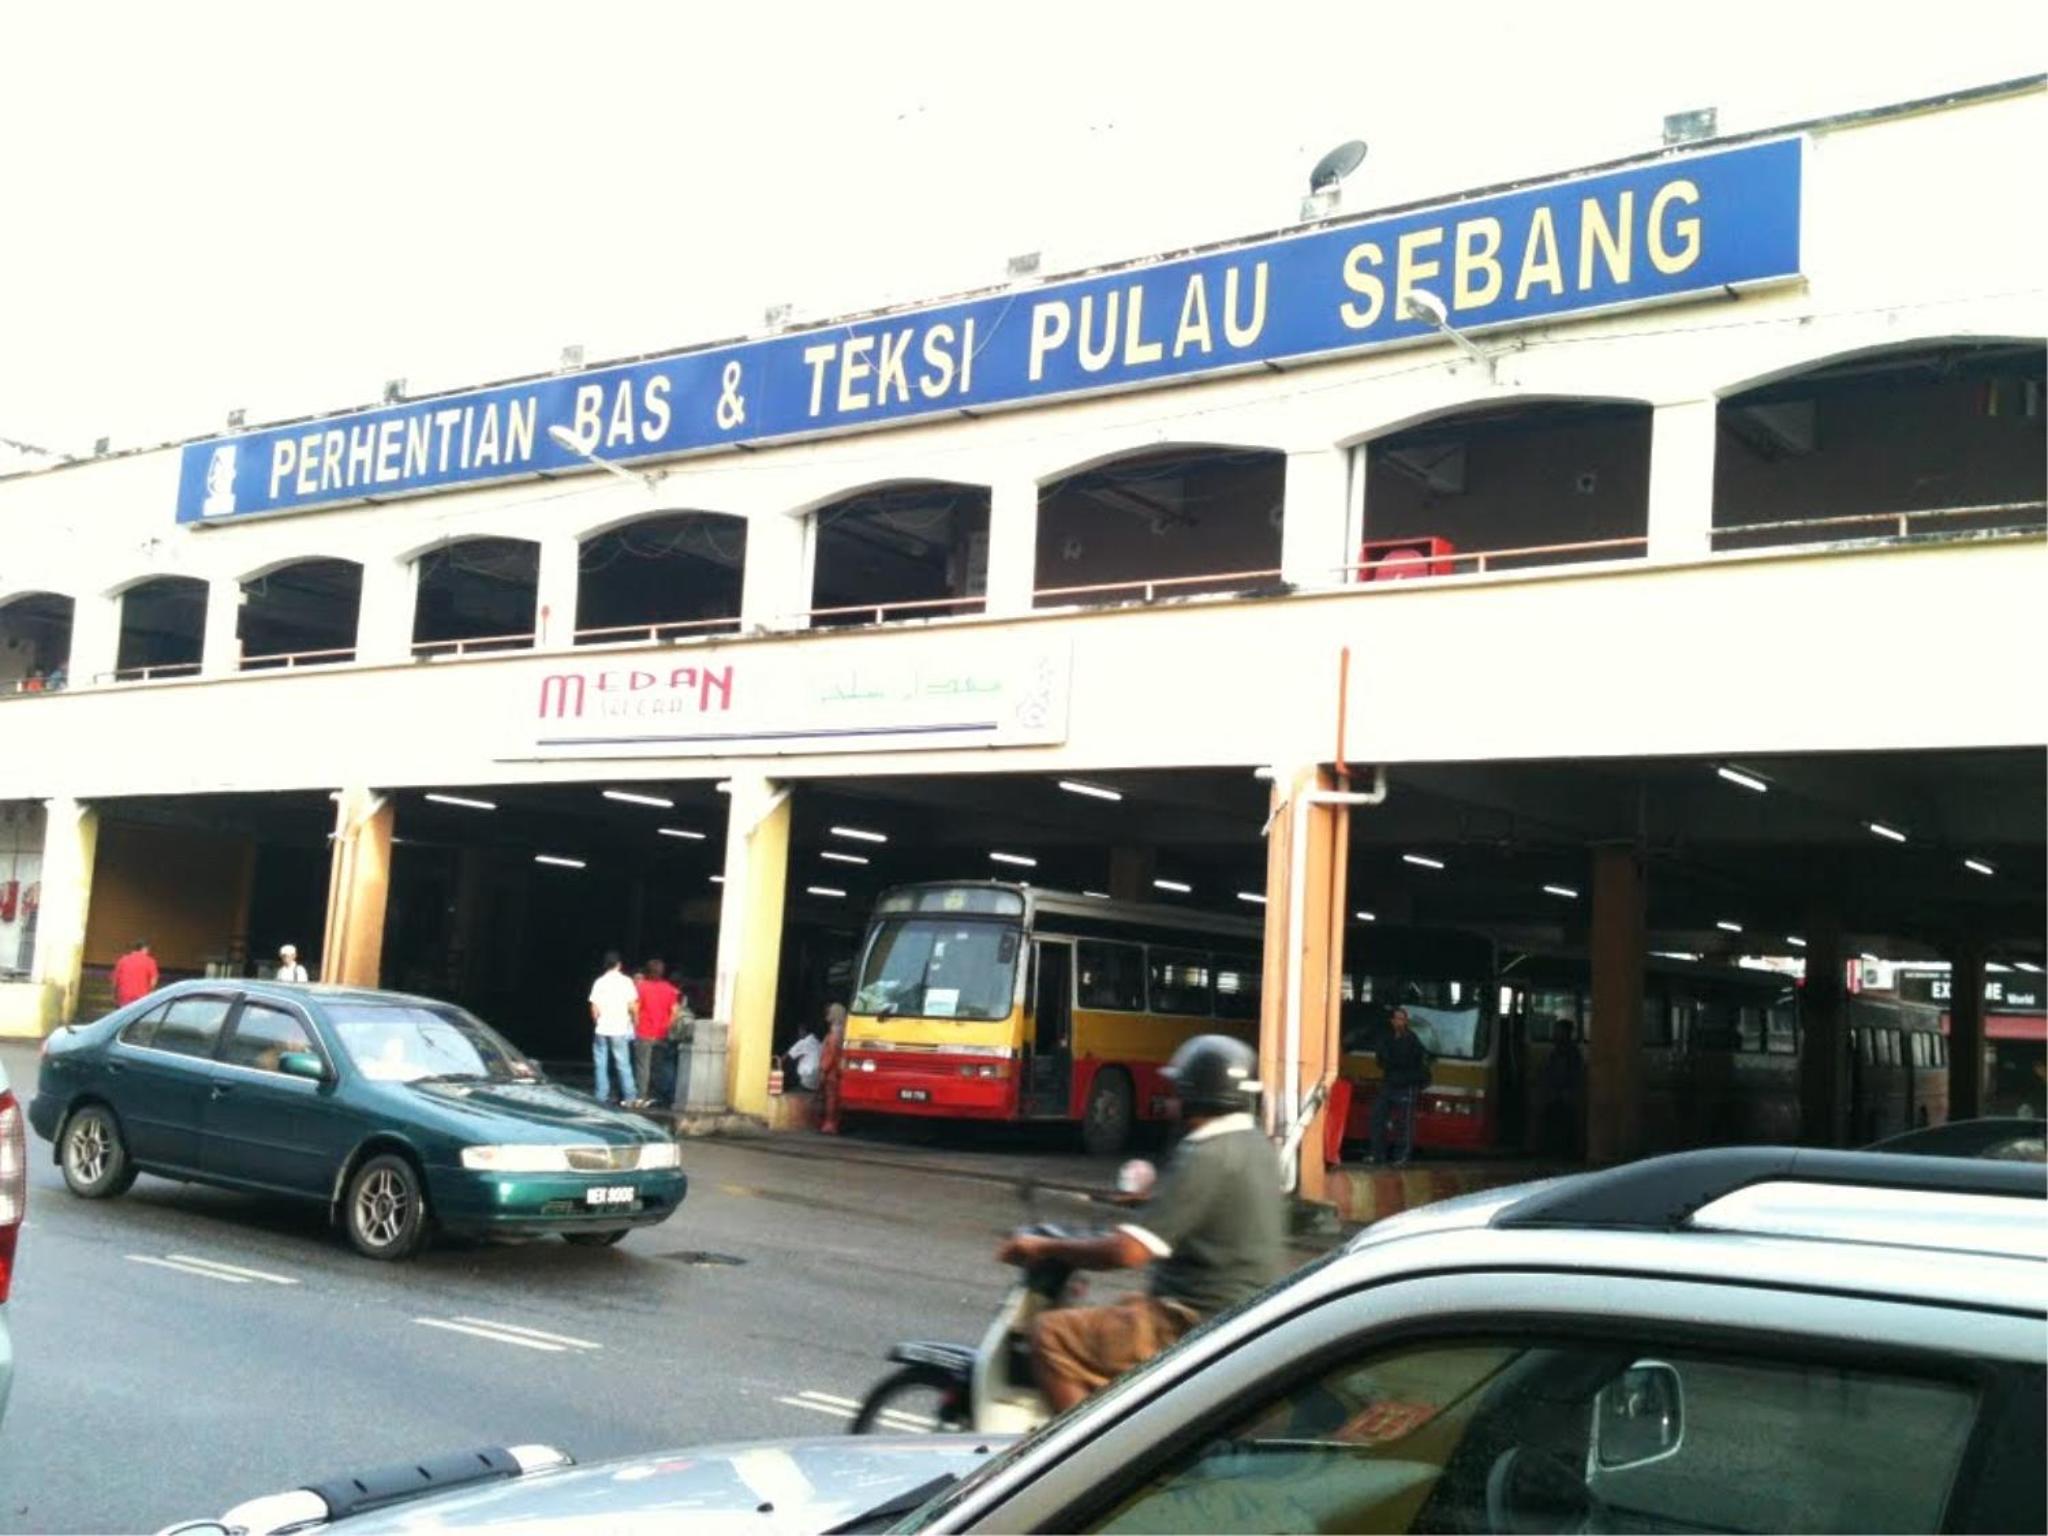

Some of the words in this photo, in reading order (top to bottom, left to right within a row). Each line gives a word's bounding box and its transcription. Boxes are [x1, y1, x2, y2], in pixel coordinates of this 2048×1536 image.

[270, 397, 537, 499] PERHENTIAN
[573, 375, 672, 447] BAS
[717, 361, 746, 430] &
[804, 318, 976, 417] TEKSI
[1028, 262, 1269, 381] PULAU
[1341, 181, 1702, 329] SEBANG
[539, 665, 733, 718] MEDAN
